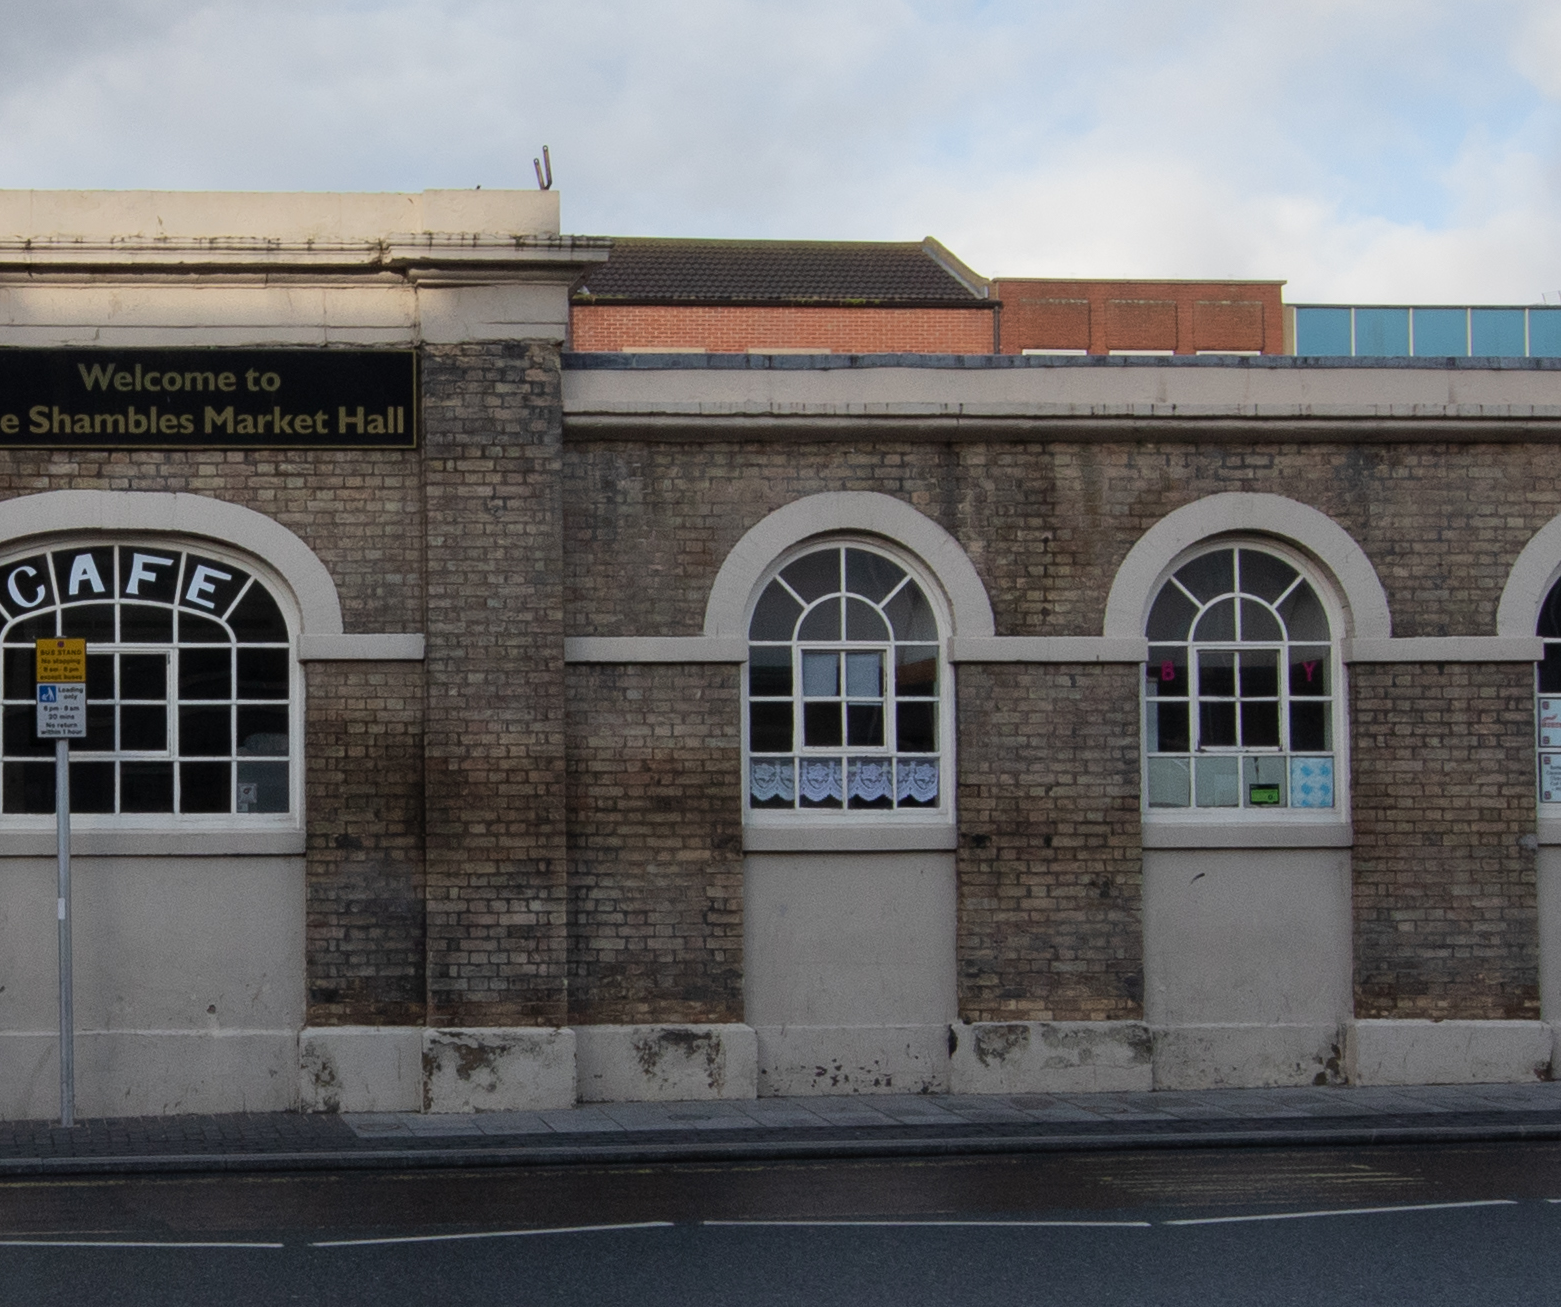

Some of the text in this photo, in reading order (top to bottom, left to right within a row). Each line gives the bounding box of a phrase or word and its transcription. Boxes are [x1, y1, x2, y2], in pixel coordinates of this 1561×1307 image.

[77, 363, 281, 392] Welcome to
[29, 405, 194, 434] Shambles
[204, 405, 328, 434] Market
[338, 405, 404, 434] Hall
[7, 552, 232, 609] CAFE
[1161, 660, 1316, 682] B Y
